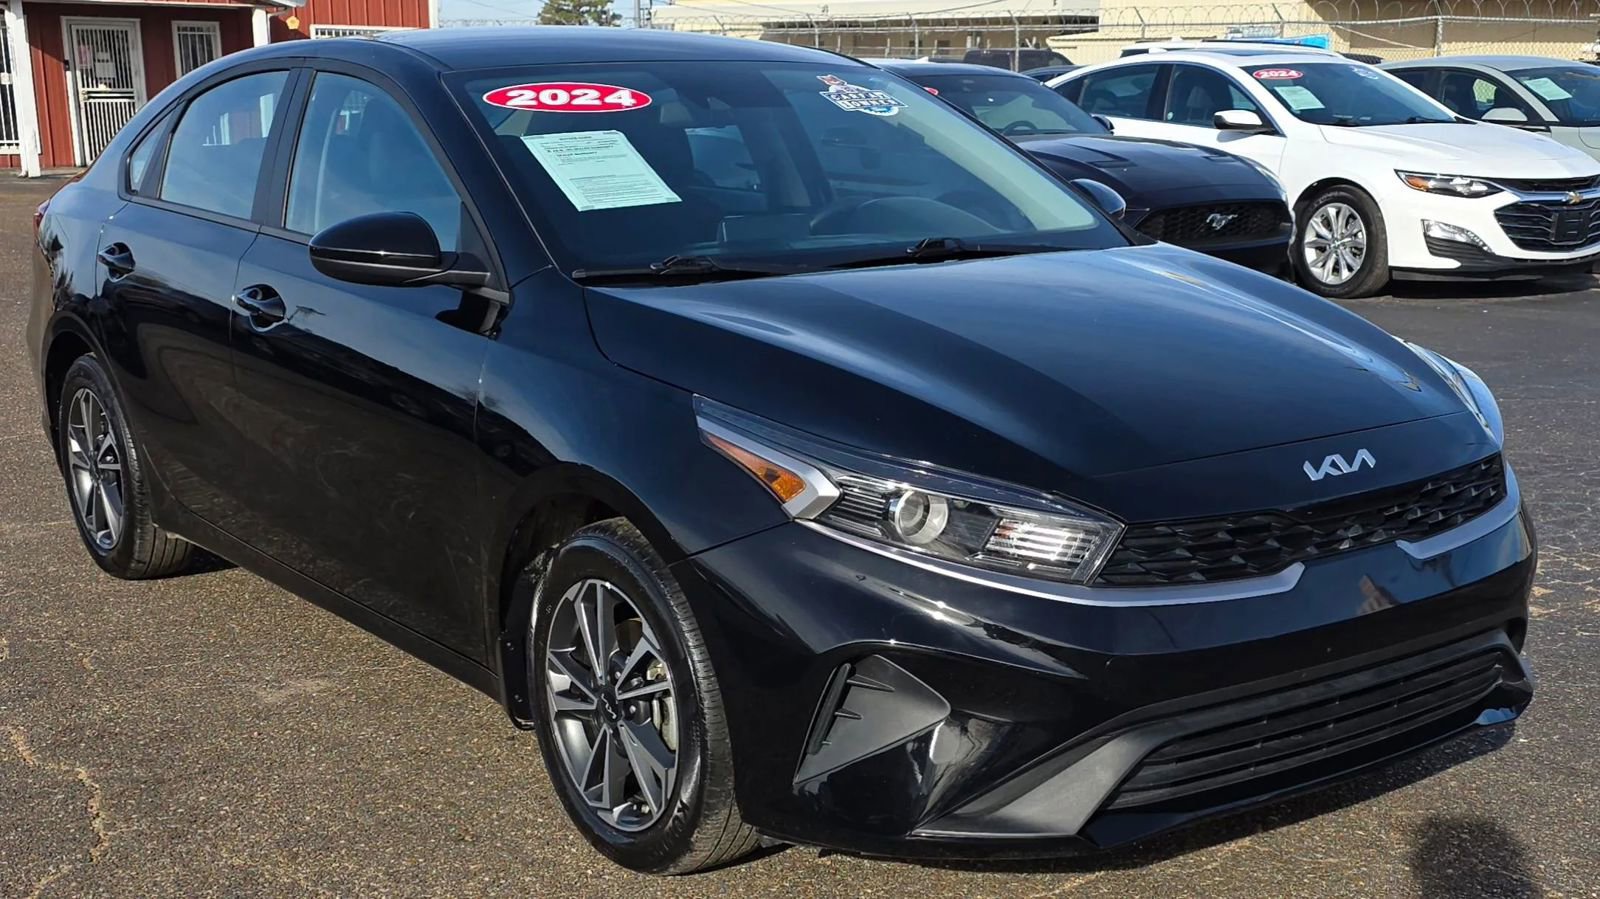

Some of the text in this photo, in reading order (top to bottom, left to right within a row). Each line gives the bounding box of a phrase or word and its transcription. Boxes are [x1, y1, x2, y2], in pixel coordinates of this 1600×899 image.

[1259, 70, 1298, 79] 2024
[505, 88, 637, 107] 2024
[1303, 448, 1376, 481] KIA
